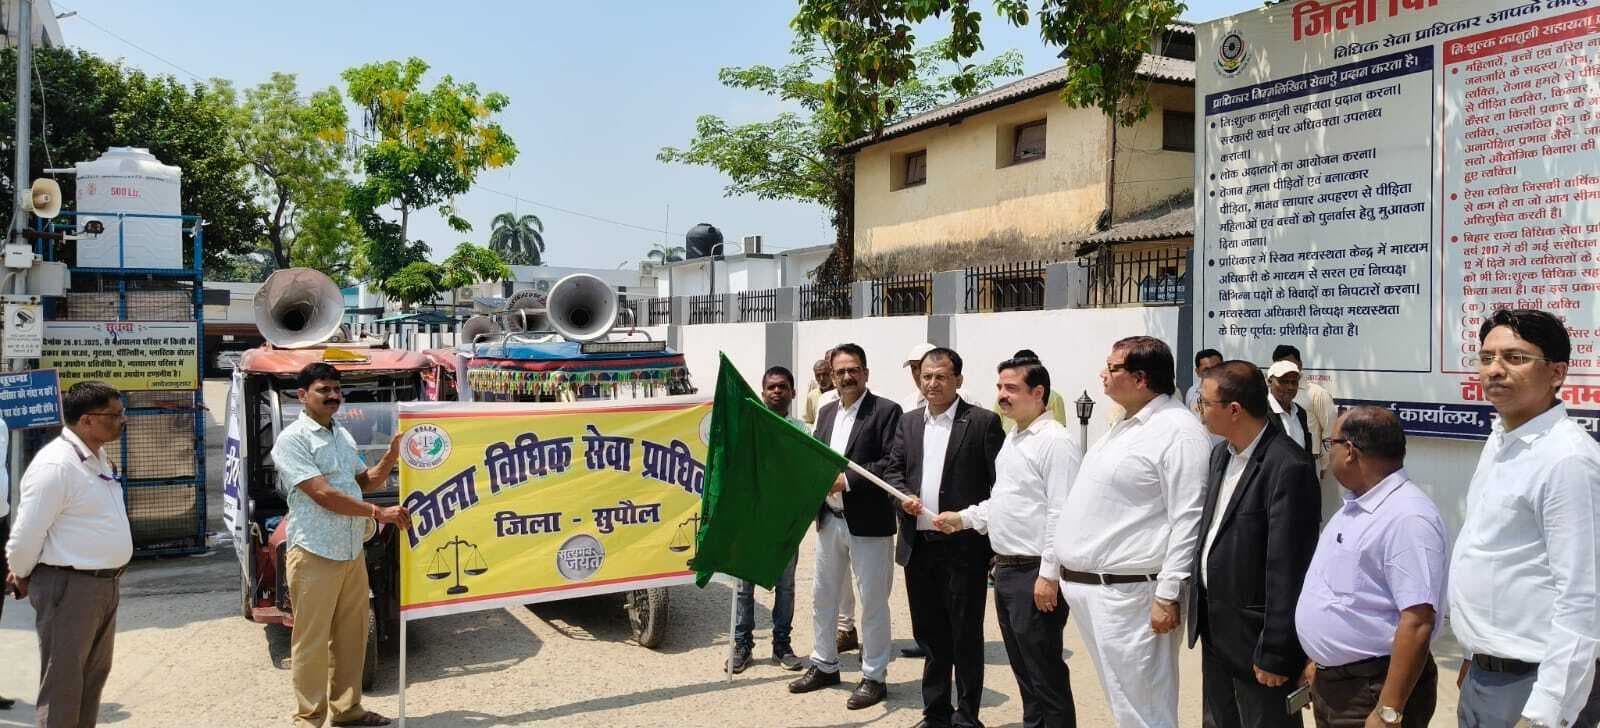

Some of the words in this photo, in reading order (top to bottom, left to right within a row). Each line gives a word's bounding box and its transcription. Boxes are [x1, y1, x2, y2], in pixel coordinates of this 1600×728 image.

[1292, 0, 1376, 41] जिला
[1334, 41, 1380, 60] विधिक
[1383, 33, 1410, 48] सेवा
[1416, 16, 1482, 41] प्राधिकार
[1486, 0, 1541, 24] आपके
[1371, 59, 1402, 74] करता
[1510, 65, 1519, 77] के
[1294, 98, 1331, 115] सहायता
[1335, 92, 1362, 107] प्रदान
[1574, 97, 1584, 108] के
[1580, 110, 1590, 121] के
[1220, 129, 1253, 145] सरकारी
[1278, 124, 1290, 134] पर
[1294, 115, 1339, 132] अधिवक्ता
[1344, 108, 1382, 124] उपलब्ध
[1580, 138, 1595, 150] की
[1221, 168, 1238, 181] लोक
[1242, 160, 1278, 177] अदालतों
[1280, 161, 1293, 171] का
[1297, 154, 1339, 169] आयोजन
[112, 187, 126, 196] 500
[1247, 183, 1270, 195] हमला
[1522, 178, 1560, 192] जिसकी
[1254, 200, 1279, 211] मानव
[1282, 195, 1313, 207] व्यापार
[1317, 190, 1358, 203] अपहरण
[1361, 185, 1372, 198] से
[1376, 182, 1412, 197] पीड़िता
[1477, 202, 1494, 211] कम
[1512, 199, 1524, 207] या
[1528, 194, 1541, 205] जो
[1219, 217, 1257, 232] महिलाओं
[1302, 211, 1315, 223] को
[1319, 207, 1355, 226] पुनर्वास
[1359, 204, 1376, 221] हेतु
[1379, 202, 1425, 220] मुआवजा
[1518, 207, 1546, 220] करती
[1219, 237, 1238, 250] दिया
[1515, 241, 1528, 252] की
[1219, 255, 1256, 267] प्राधिकार
[1259, 251, 1267, 263] में
[1269, 251, 1294, 263] स्थित
[1297, 249, 1346, 261] मध्यस्थता
[1349, 244, 1373, 258] केन्द्र
[1377, 242, 1387, 255] में
[1390, 243, 1428, 255] माध्यम
[1219, 271, 1257, 285] अधिकारी
[1261, 270, 1270, 281] के
[1273, 271, 1304, 281] माध्यम
[1308, 267, 1317, 279] से
[1320, 268, 1345, 278] सरल
[1349, 263, 1365, 278] एवं
[1368, 262, 1406, 277] निष्पक्ष
[1276, 286, 1285, 299] के
[1288, 285, 1319, 299] विवादों
[1321, 288, 1334, 297] का
[1338, 283, 1380, 297] निपटारों
[1219, 308, 1261, 319] मध्यस्थता
[1264, 304, 1306, 317] अधिकारी
[1309, 304, 1344, 318] निष्पक्ष
[1347, 305, 1400, 316] मध्यस्थता
[1218, 324, 1227, 335] के
[1230, 324, 1247, 337] लिए
[1280, 323, 1319, 337] प्रशिक्षित
[1323, 322, 1343, 337] होता
[1401, 405, 1485, 428] कार्यालय,
[402, 465, 479, 548] जिला
[484, 432, 573, 494] विधिक
[582, 424, 634, 472] सेवा
[493, 511, 563, 537] जिला
[592, 500, 661, 534] सुपौल
